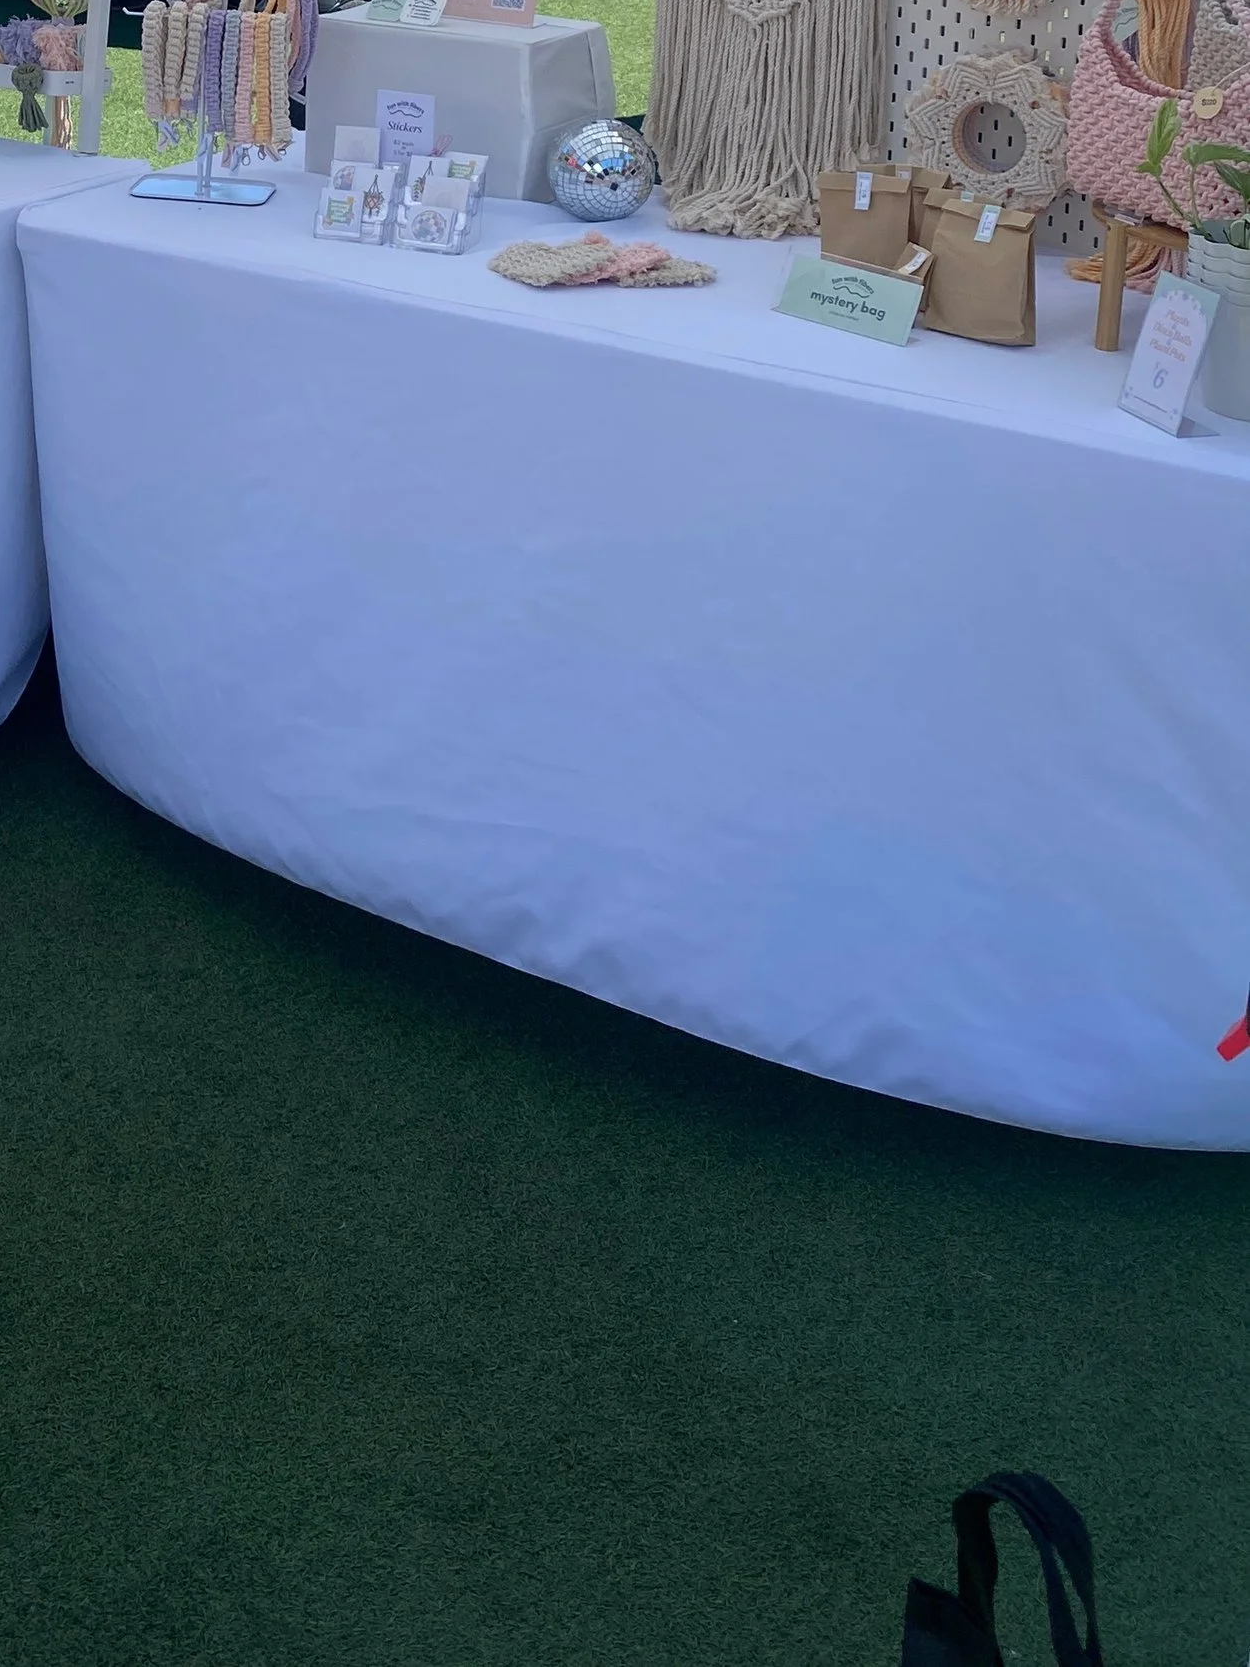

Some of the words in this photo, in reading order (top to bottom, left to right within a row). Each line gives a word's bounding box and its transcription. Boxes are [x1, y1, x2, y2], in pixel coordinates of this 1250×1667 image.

[386, 120, 423, 134] Stickers
[810, 291, 858, 313] mystery
[860, 300, 886, 321] bag
